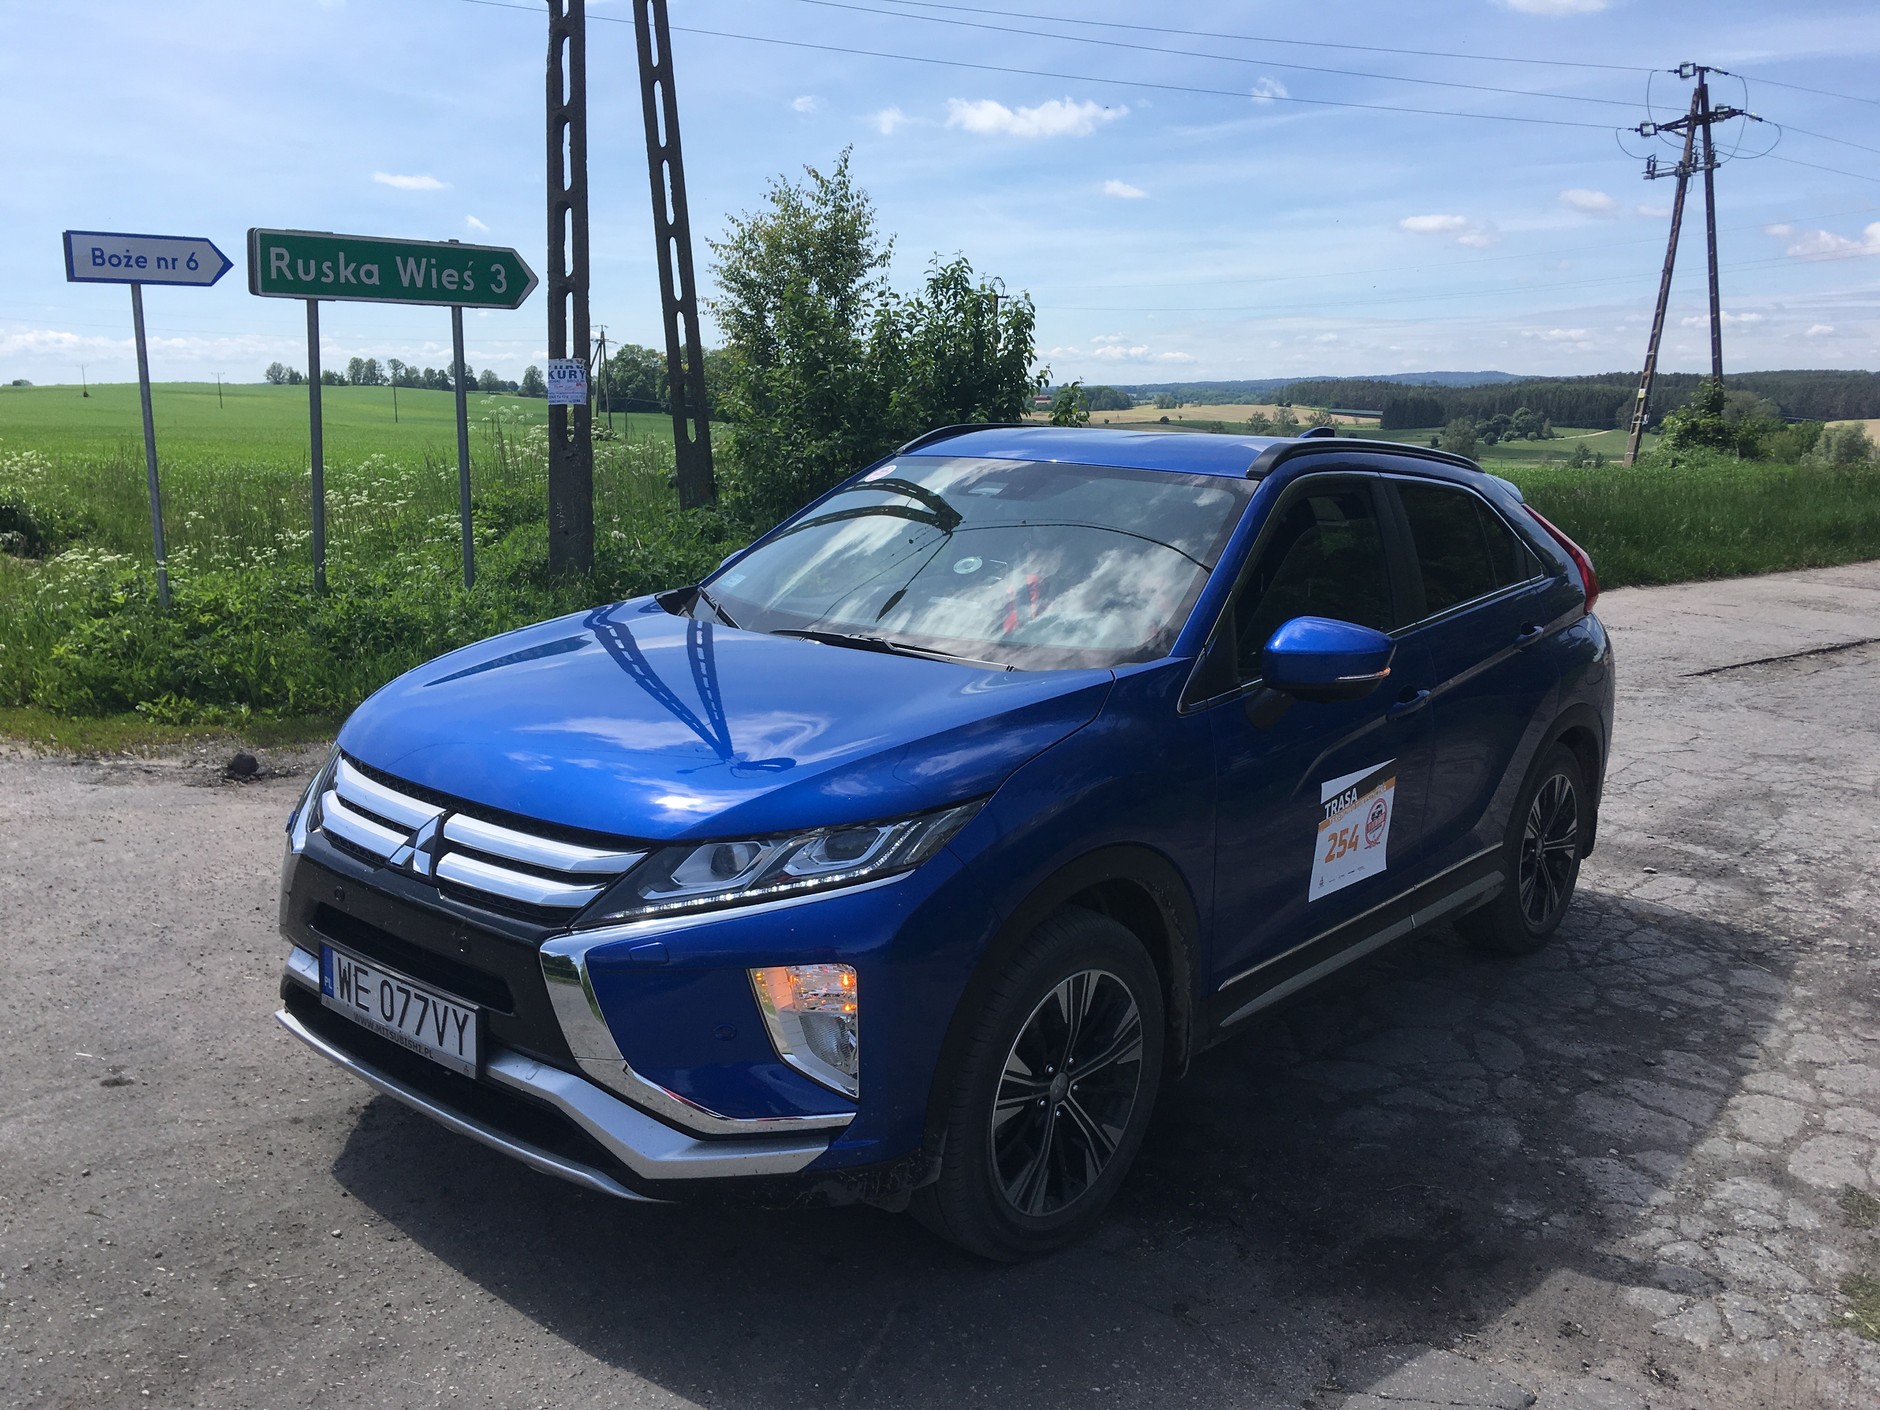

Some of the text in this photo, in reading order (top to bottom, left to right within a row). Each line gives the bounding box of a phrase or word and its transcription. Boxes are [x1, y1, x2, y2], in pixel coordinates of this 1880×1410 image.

[91, 247, 199, 271] Boże nr 6
[269, 247, 508, 294] Ruska Wieś 3
[548, 370, 586, 379] KURY
[1324, 787, 1358, 820] TRASA
[1324, 823, 1359, 864] 254
[324, 975, 333, 990] PL
[337, 956, 470, 1056] WE 077VY
[353, 1011, 435, 1060] WWW.MITSUBISHI.PL
